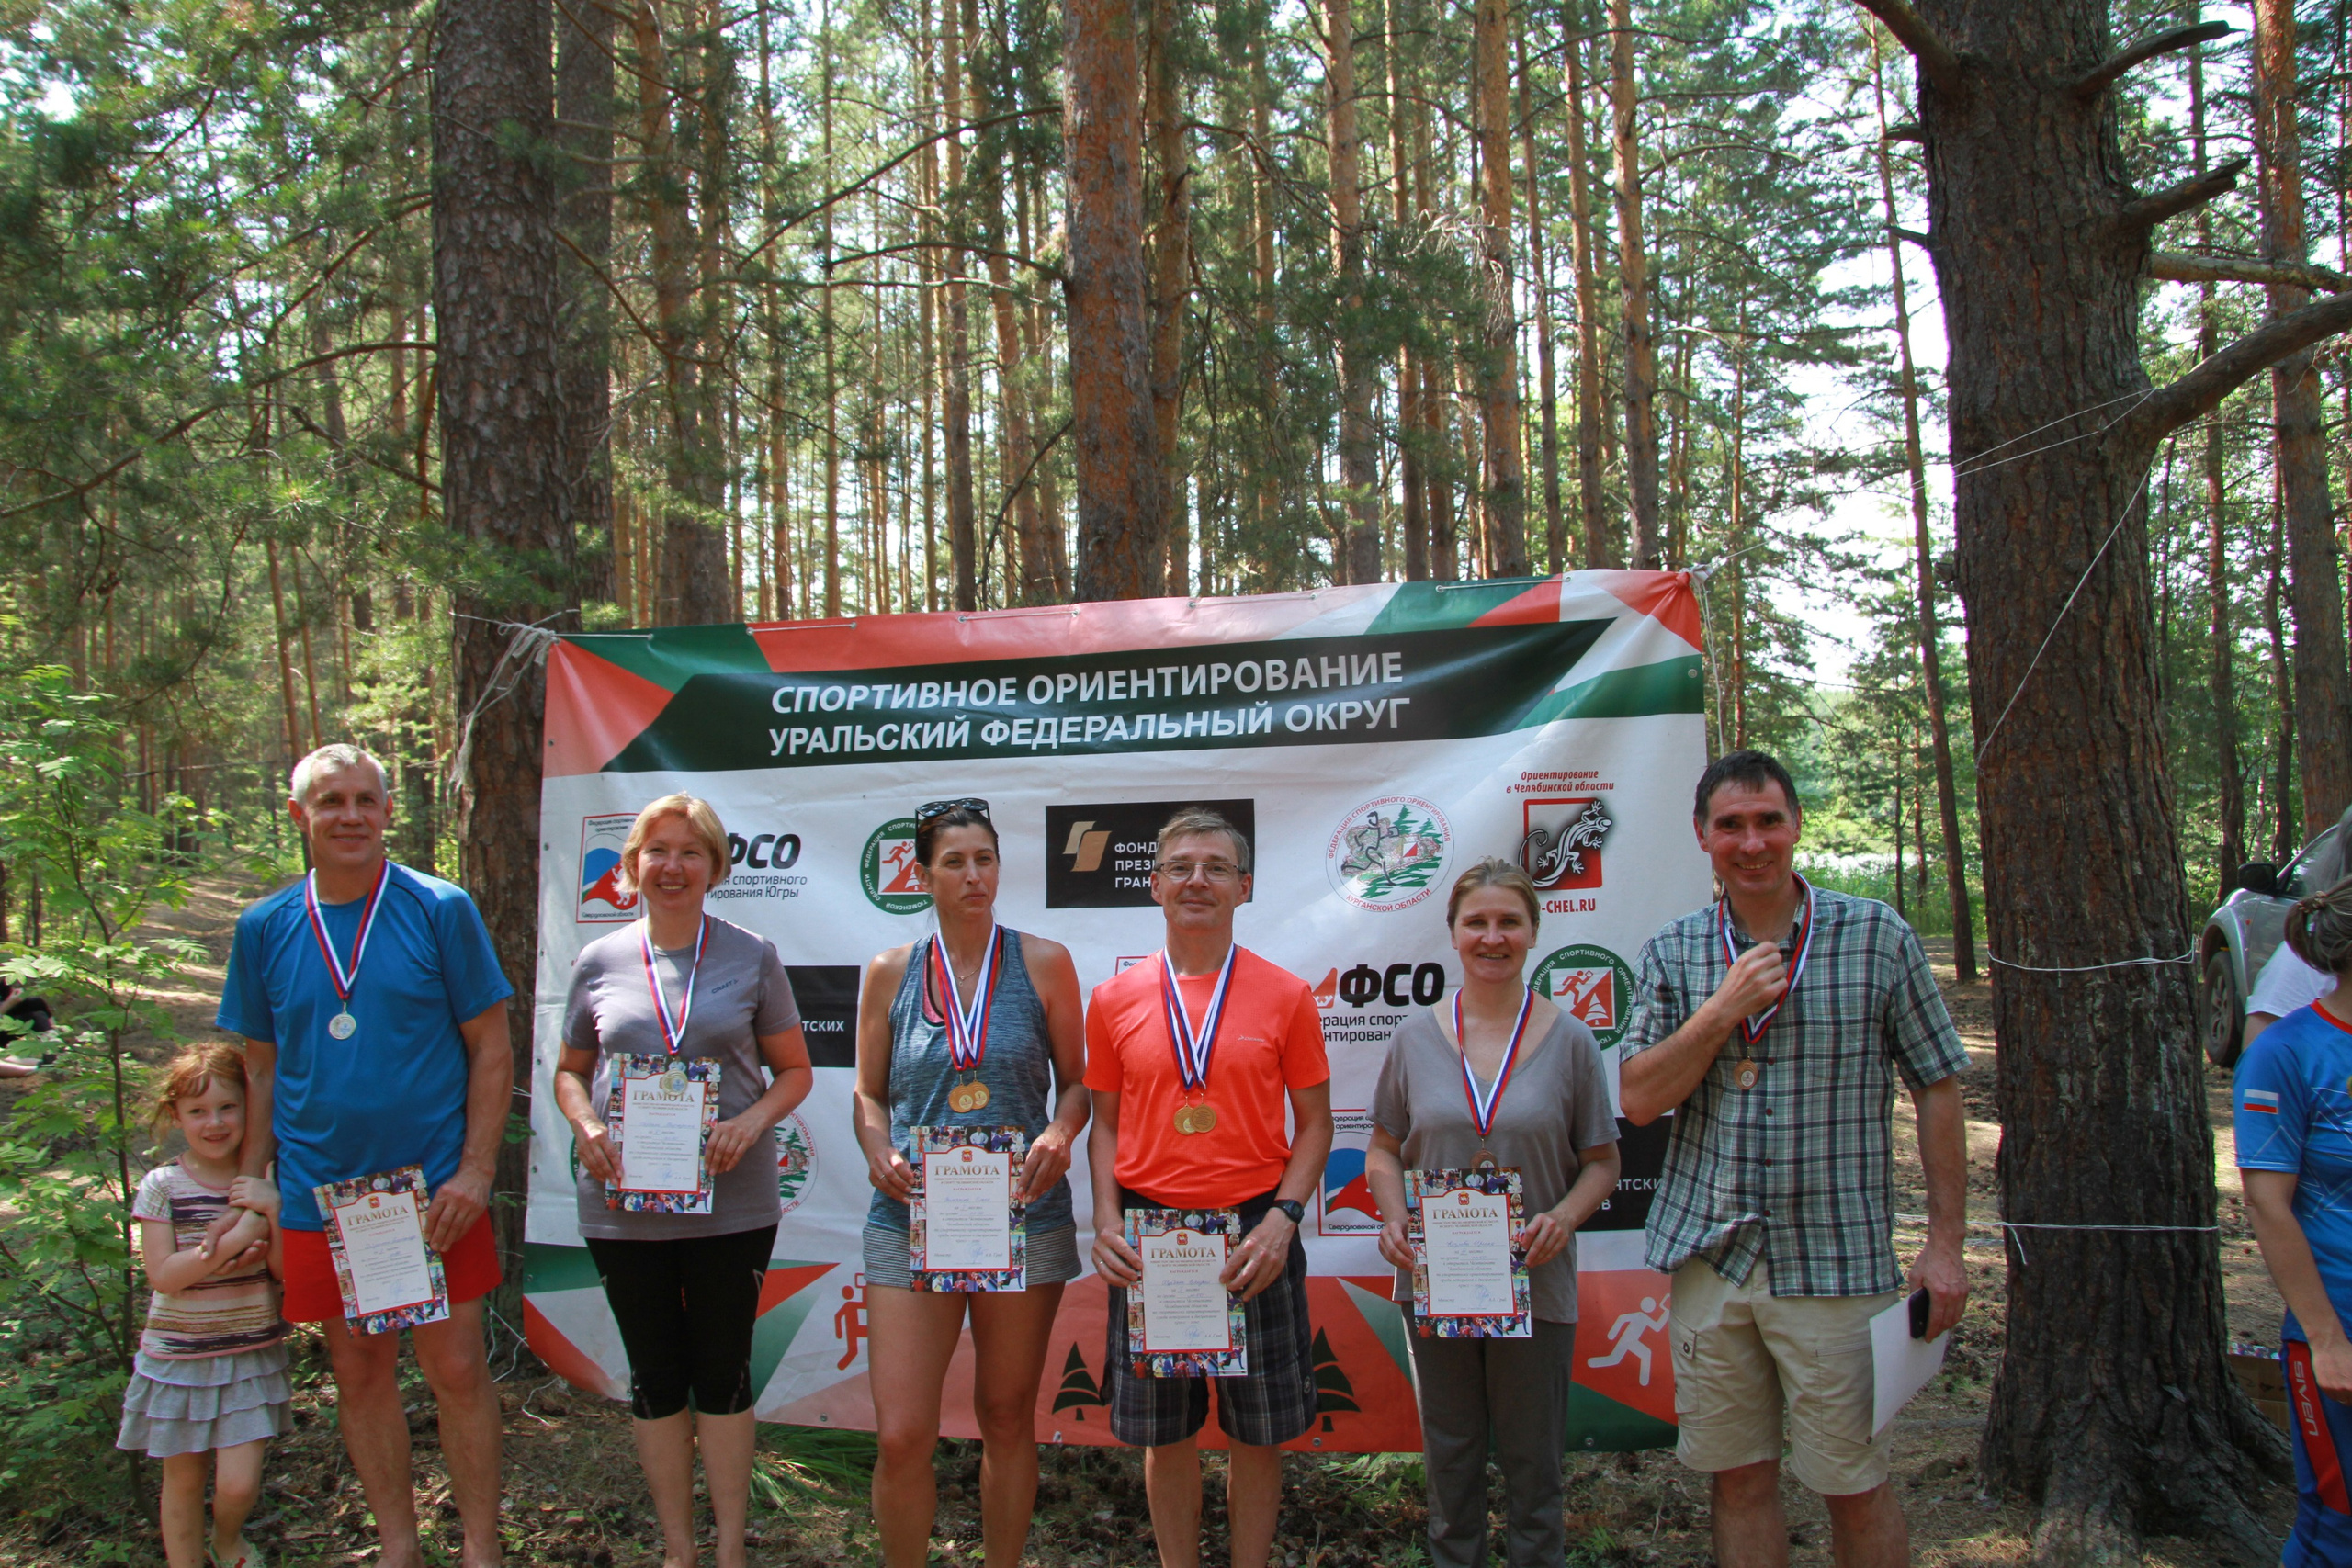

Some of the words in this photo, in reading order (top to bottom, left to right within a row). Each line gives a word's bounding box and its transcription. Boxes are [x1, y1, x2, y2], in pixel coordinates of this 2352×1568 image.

[771, 677, 1017, 714] СПОРТИВНОЕ
[1027, 652, 1404, 705] ОРИЕНТИРОВАНИЕ
[769, 714, 970, 756] УРАЛЬСКИЙ
[980, 700, 1273, 750] ФЕДЕРАЛЬНЫЙ
[1284, 698, 1410, 732] ОКРУГ
[1521, 771, 1599, 783] Ориентирование
[1514, 781, 1573, 793] Челябинской
[1575, 781, 1614, 792] области
[1328, 816, 1352, 859] ФЕДЕРАЦИЯ
[1351, 796, 1406, 818] СПОРТИВНОГО
[1407, 796, 1451, 842] ОРИЕНТИРОВАНИЯ
[865, 830, 885, 868] ФЕДЕРАЦИЯ
[1114, 841, 1159, 854] ФОНД
[732, 875, 808, 887] спортивного
[706, 888, 763, 901] тирования
[765, 886, 799, 900] Югры
[1345, 894, 1393, 911] КУРГАНСКОЙ
[1394, 888, 1431, 910] ОБЛАСТИ
[1538, 898, 1596, 914] -CHEL.RU
[1533, 959, 1555, 992] ДЕРАЦИЯ
[1559, 949, 1615, 965] СПОРТИВНОГО
[1339, 962, 1445, 1008] ФСО
[632, 1090, 695, 1103] ГРАМОТА
[934, 1164, 1000, 1176] ГРАМОТА
[346, 1205, 409, 1226] ГРАМОТА
[1432, 1207, 1498, 1220] ГРАМОТА
[1150, 1247, 1216, 1258] ГРАМОТА
